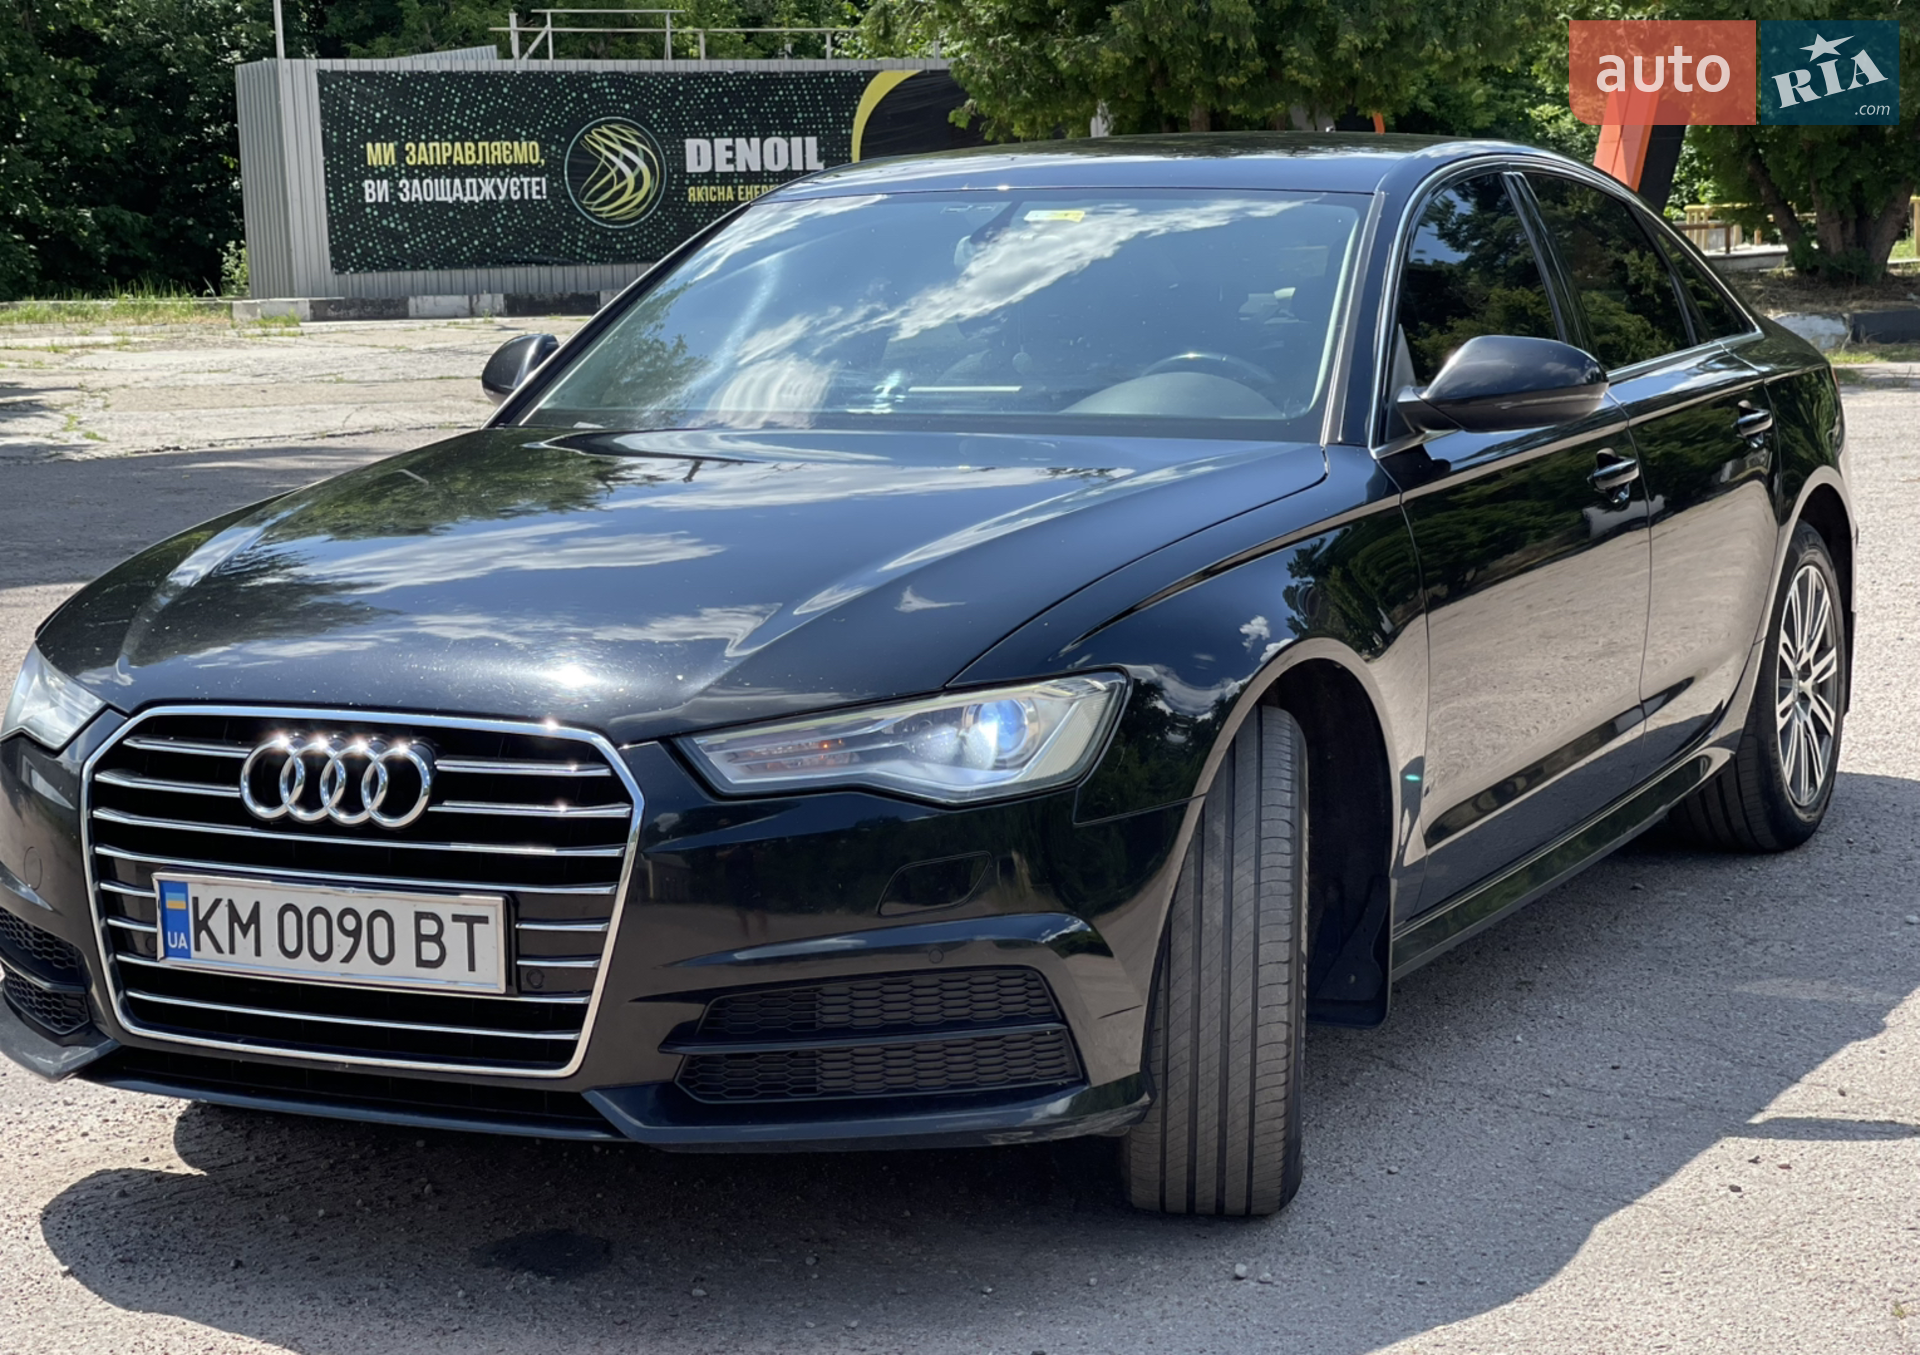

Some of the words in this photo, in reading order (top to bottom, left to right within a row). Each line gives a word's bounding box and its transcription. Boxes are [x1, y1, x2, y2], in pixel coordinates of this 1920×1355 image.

[366, 142, 396, 166] МИ
[405, 141, 546, 166] ЗАПРАВЛЯЄМО,
[685, 136, 825, 173] DENOIL
[364, 179, 390, 203] ВИ
[399, 177, 548, 203] ЗАОЩАДЖУЄТЕ!
[688, 186, 735, 202] ЯКІСНА
[167, 931, 188, 950] UA
[277, 902, 395, 966] 0090
